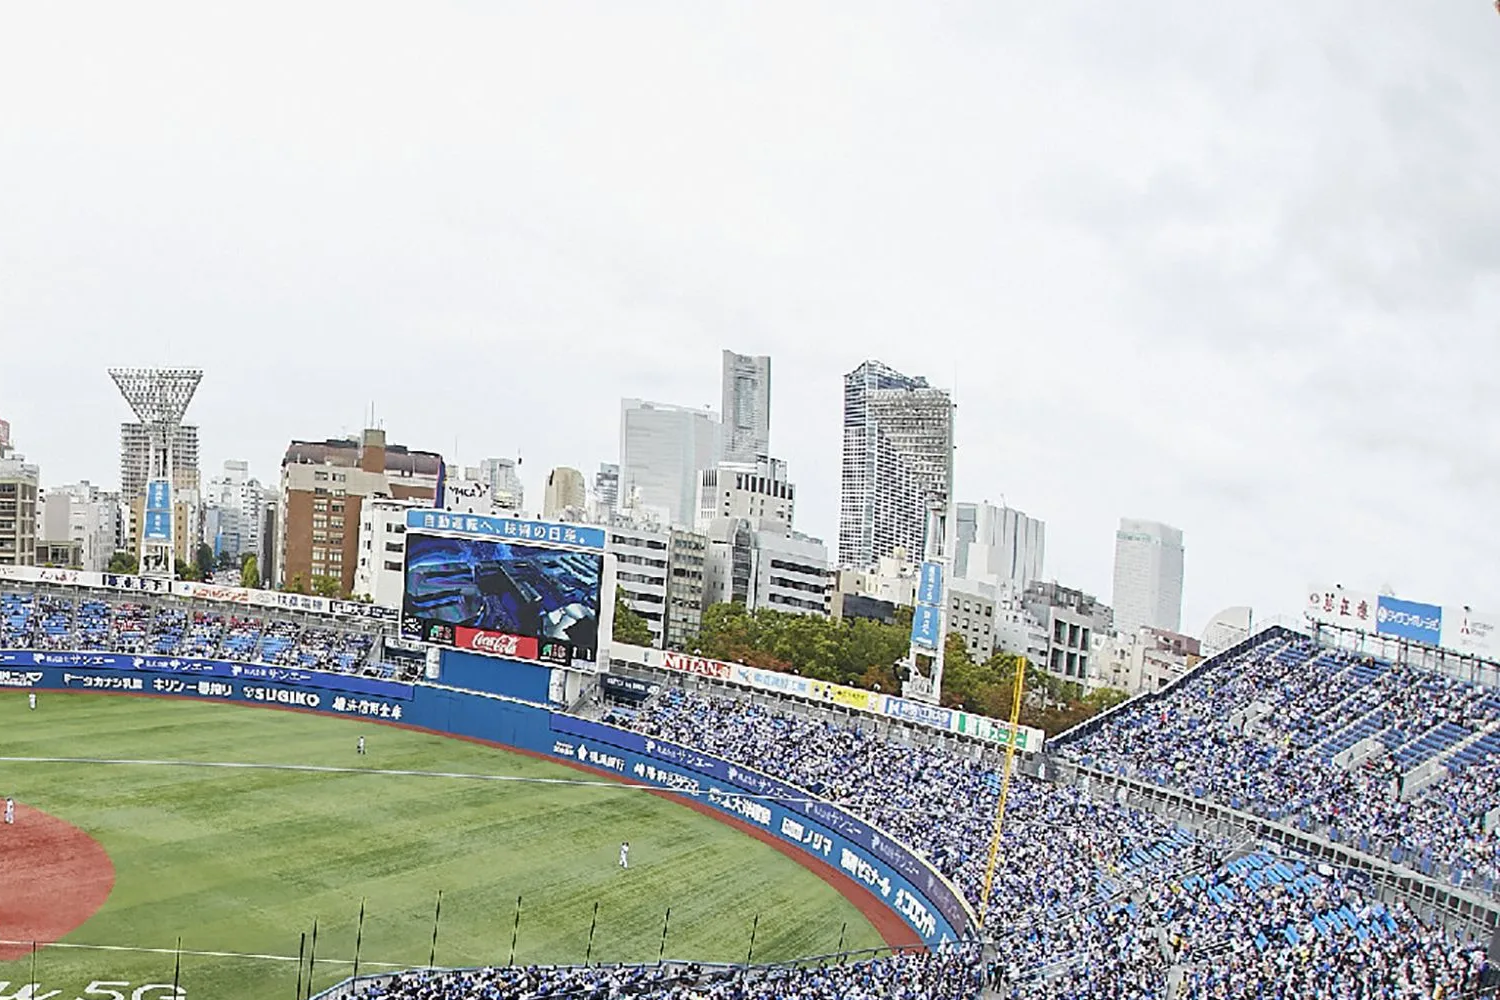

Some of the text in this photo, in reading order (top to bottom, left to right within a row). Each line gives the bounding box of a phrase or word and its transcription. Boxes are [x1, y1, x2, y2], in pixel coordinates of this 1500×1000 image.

[153, 679, 232, 696] キリン一番搾り
[255, 688, 320, 707] SUGIKO
